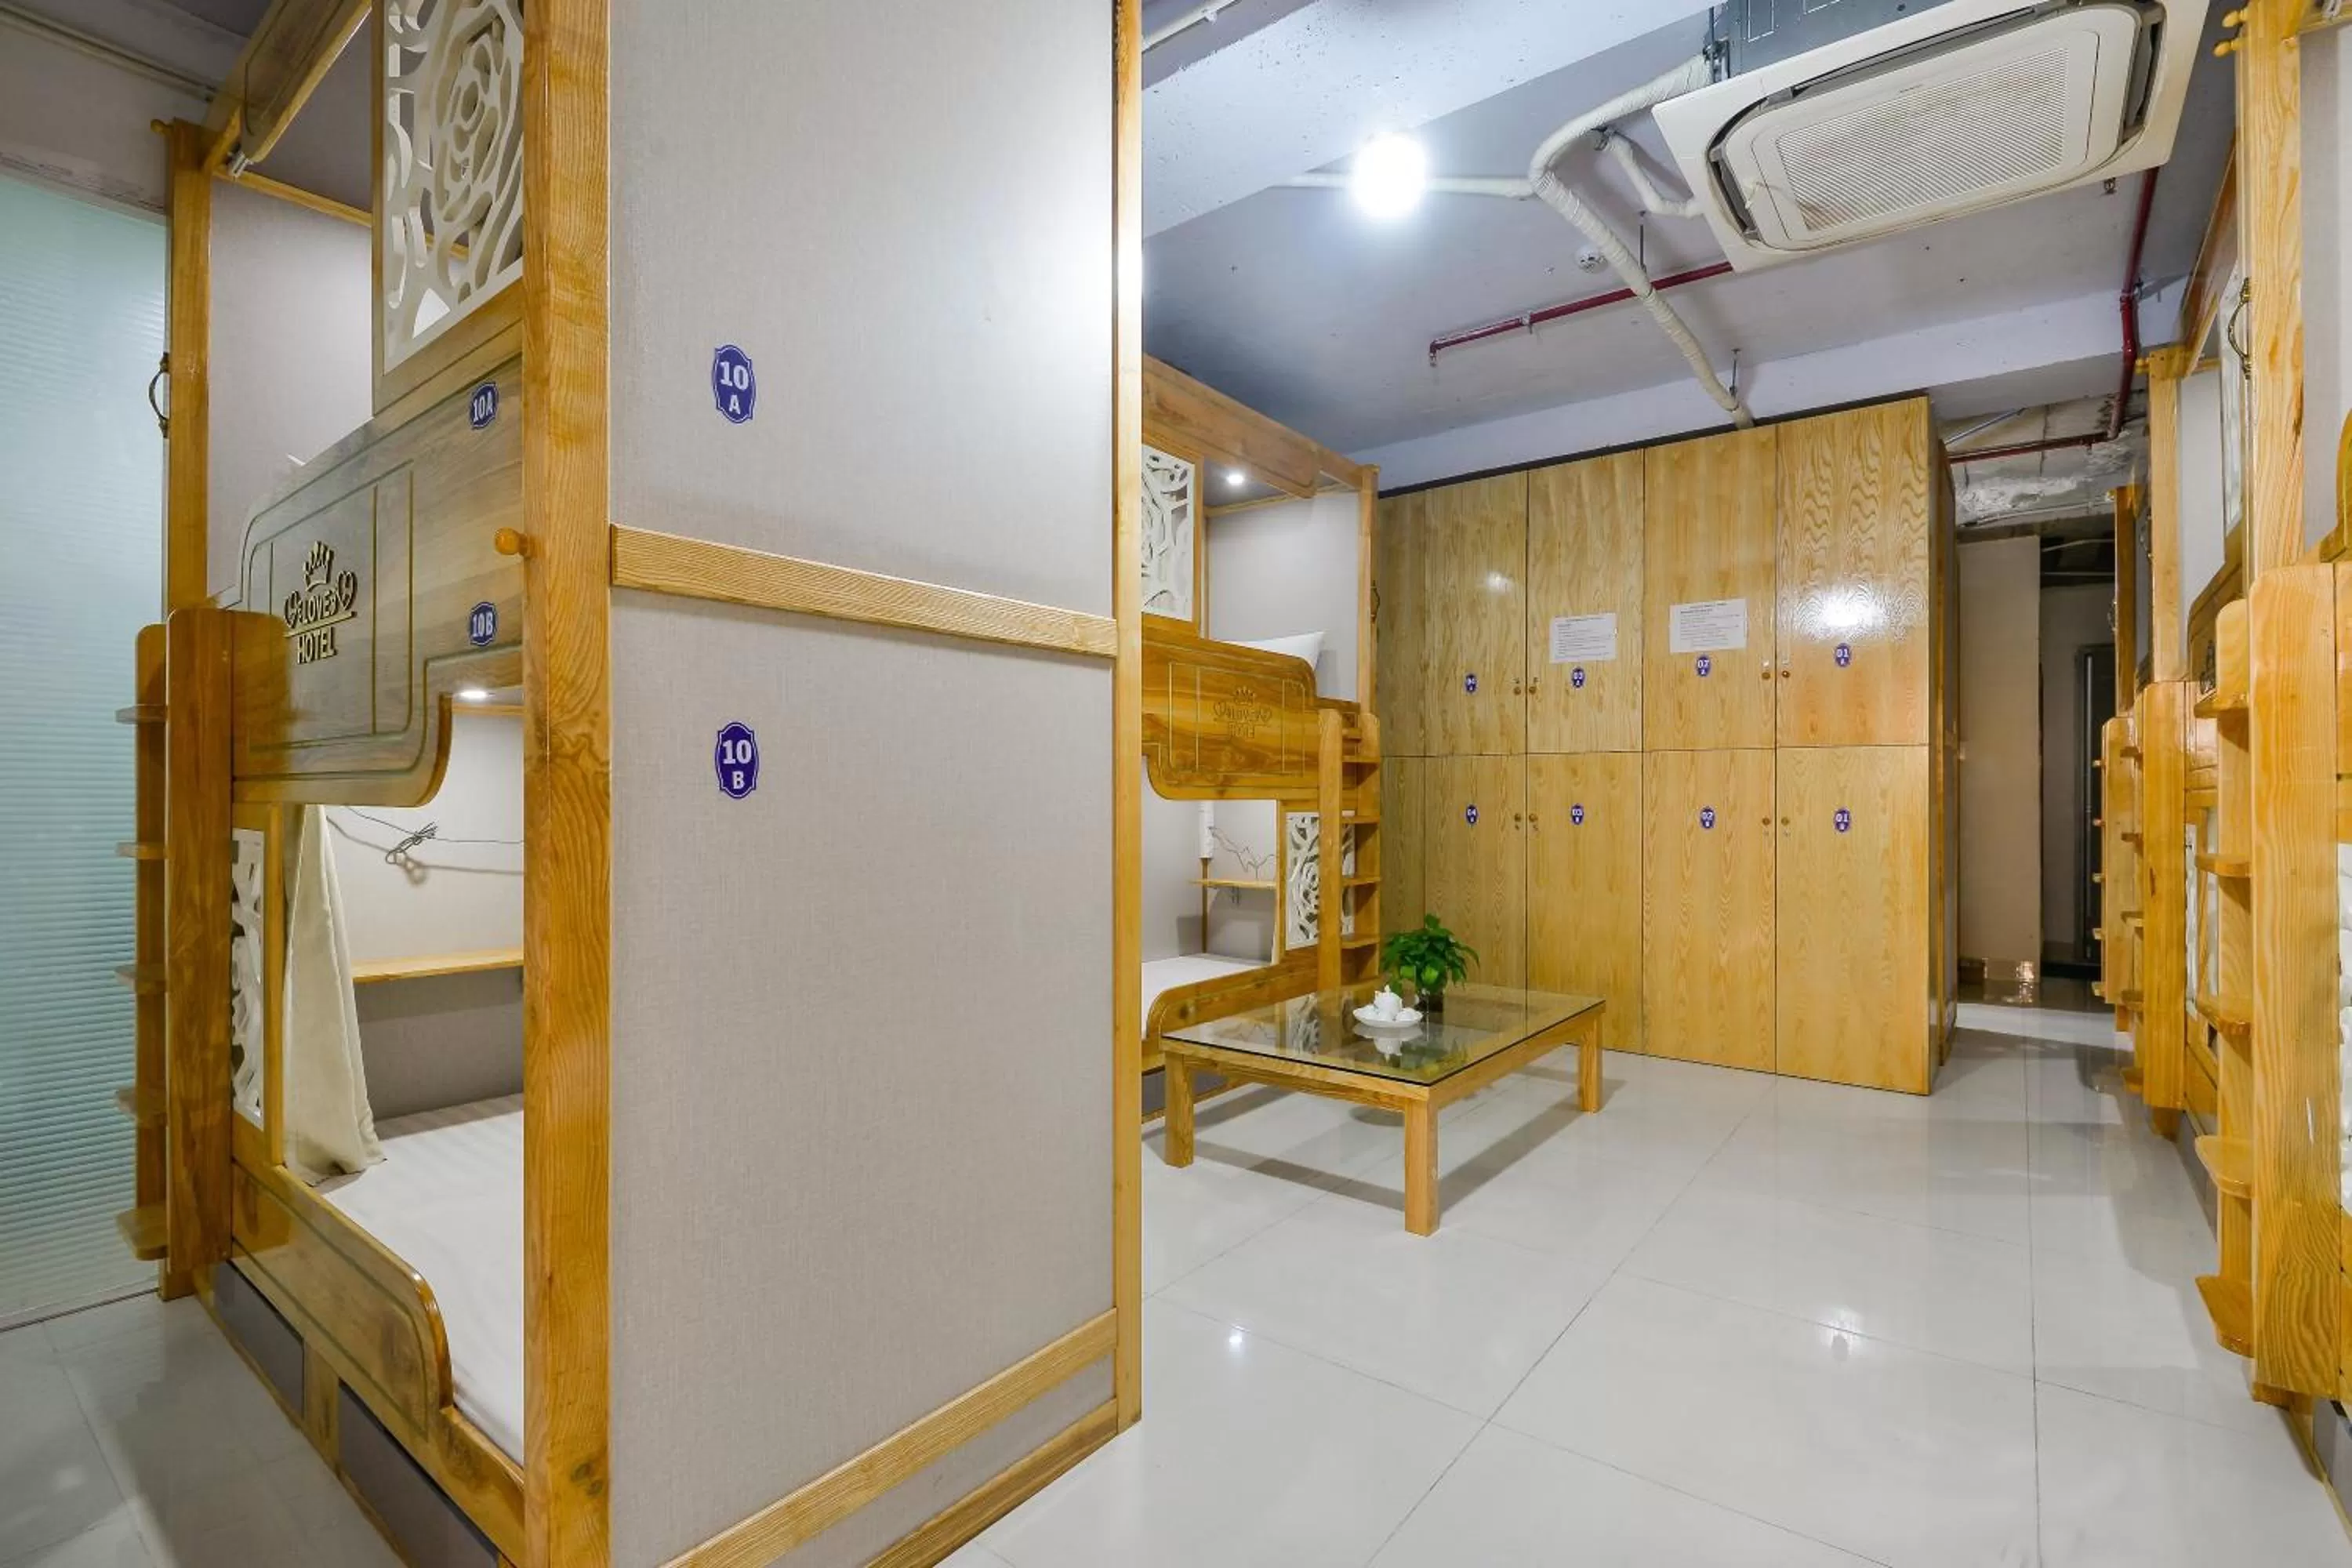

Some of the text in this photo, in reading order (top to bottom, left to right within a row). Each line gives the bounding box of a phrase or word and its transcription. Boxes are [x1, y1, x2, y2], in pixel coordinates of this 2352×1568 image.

[720, 361, 750, 390] 10
[473, 390, 494, 423] 10A
[728, 394, 741, 415] A
[472, 612, 493, 637] 10B
[297, 626, 338, 664] HOTEL
[1836, 648, 1849, 658] 01
[722, 739, 752, 764] 10
[731, 771, 745, 789] B
[1835, 813, 1849, 822] 01
